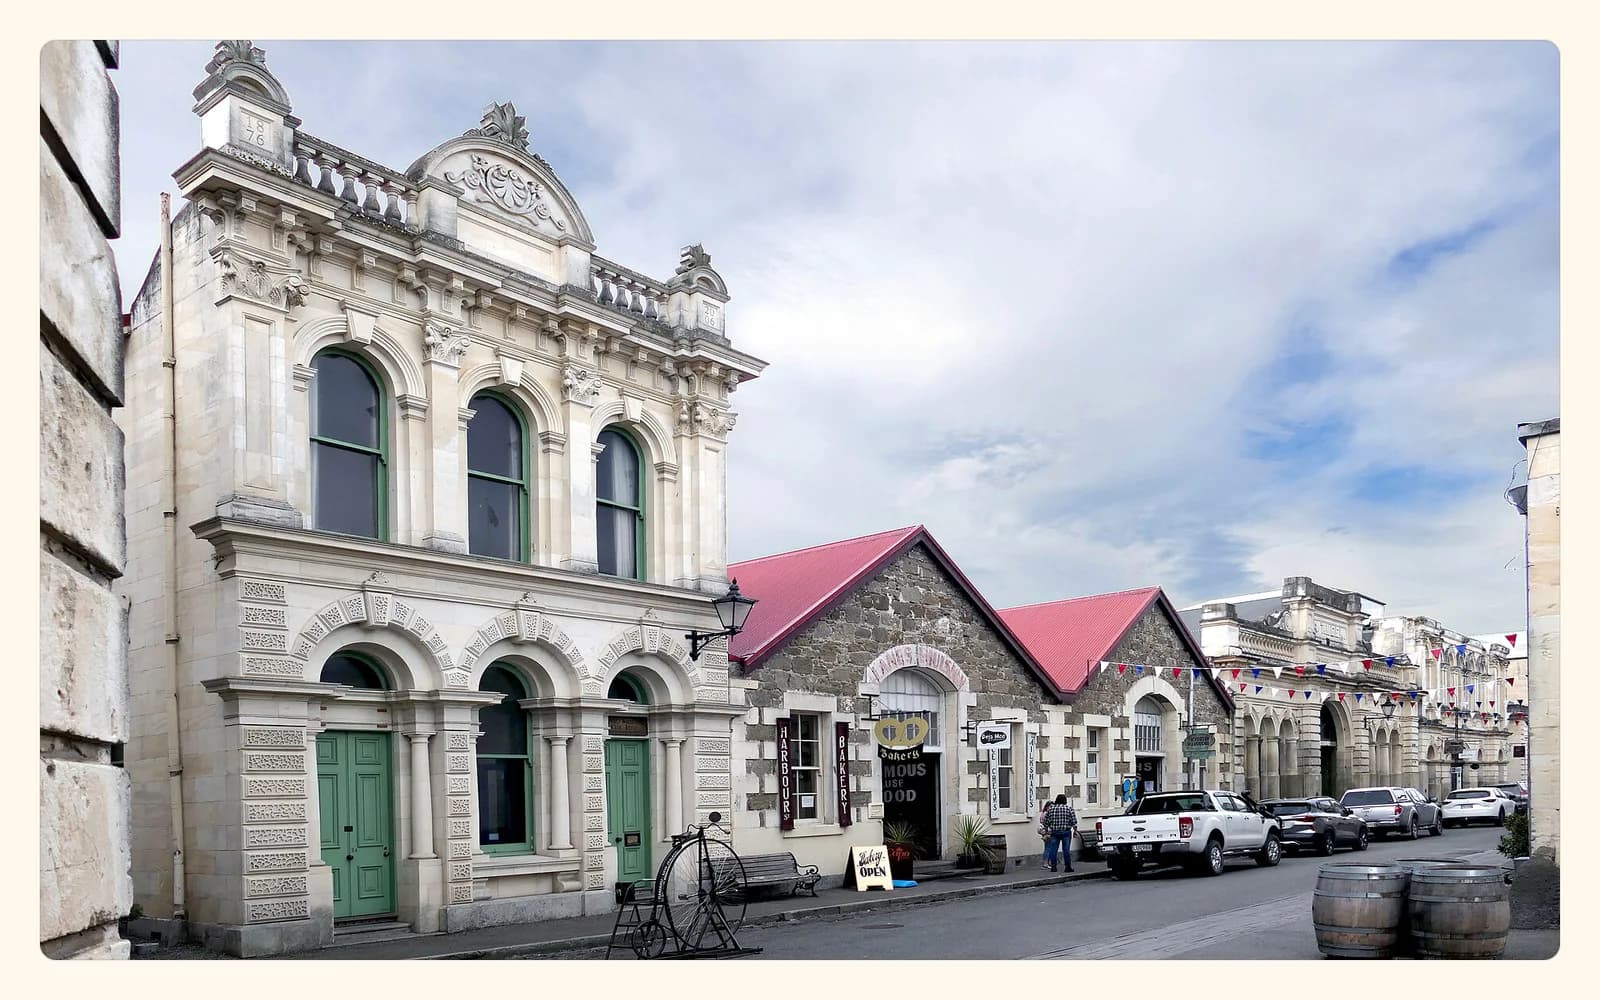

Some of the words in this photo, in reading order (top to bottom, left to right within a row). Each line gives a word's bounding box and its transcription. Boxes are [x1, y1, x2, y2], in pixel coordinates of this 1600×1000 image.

[246, 128, 265, 146] 76
[780, 726, 791, 813] HARBOUR
[839, 736, 848, 815] BAKERY
[860, 867, 887, 877] OPEN
